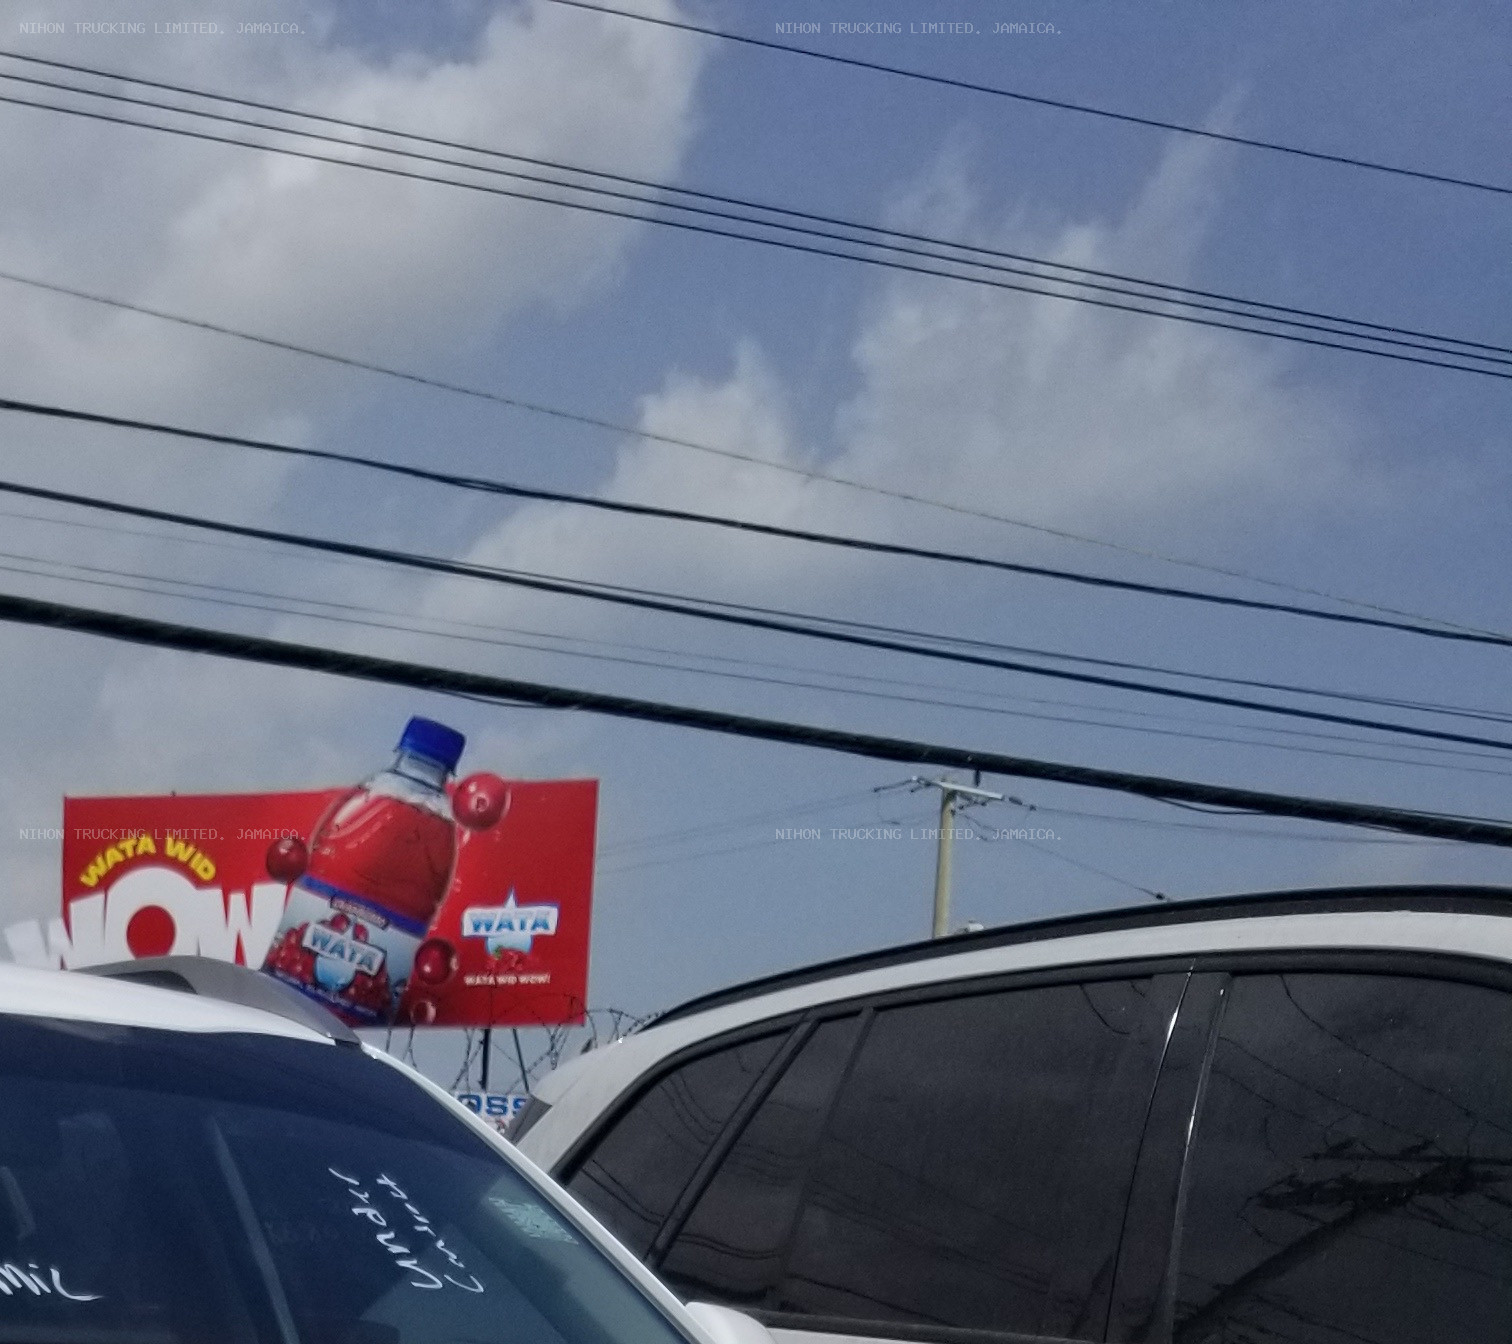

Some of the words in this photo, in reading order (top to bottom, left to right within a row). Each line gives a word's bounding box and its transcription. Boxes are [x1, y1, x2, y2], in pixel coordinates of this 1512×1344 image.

[79, 833, 156, 887] WATA
[165, 834, 217, 881] WID
[4, 865, 287, 970] WOW
[467, 909, 552, 933] WATA
[309, 926, 378, 973] WATA
